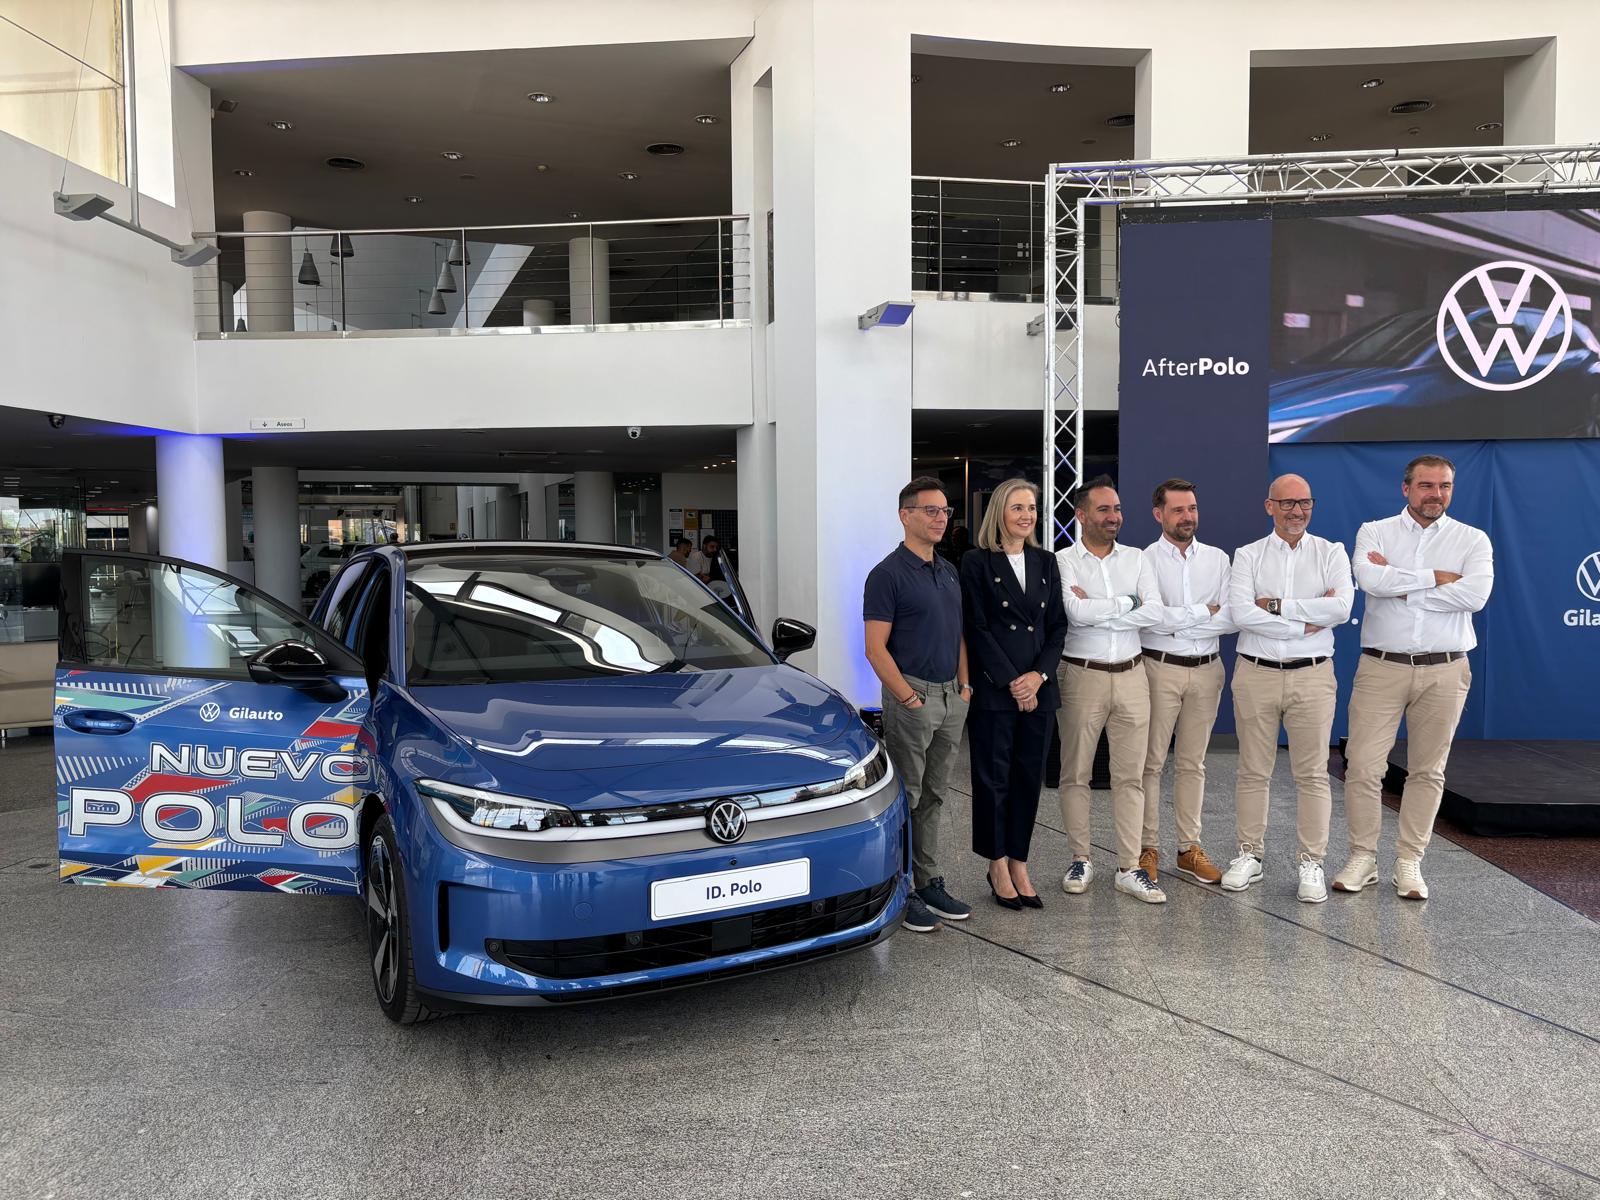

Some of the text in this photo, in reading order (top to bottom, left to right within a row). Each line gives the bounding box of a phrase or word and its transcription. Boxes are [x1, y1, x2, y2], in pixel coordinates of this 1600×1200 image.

[1142, 357, 1250, 377] AfterPolo
[229, 707, 283, 721] Gilauto
[150, 741, 367, 784] NUEVO
[68, 786, 358, 850] POLO
[706, 879, 762, 900] ID. Polo
